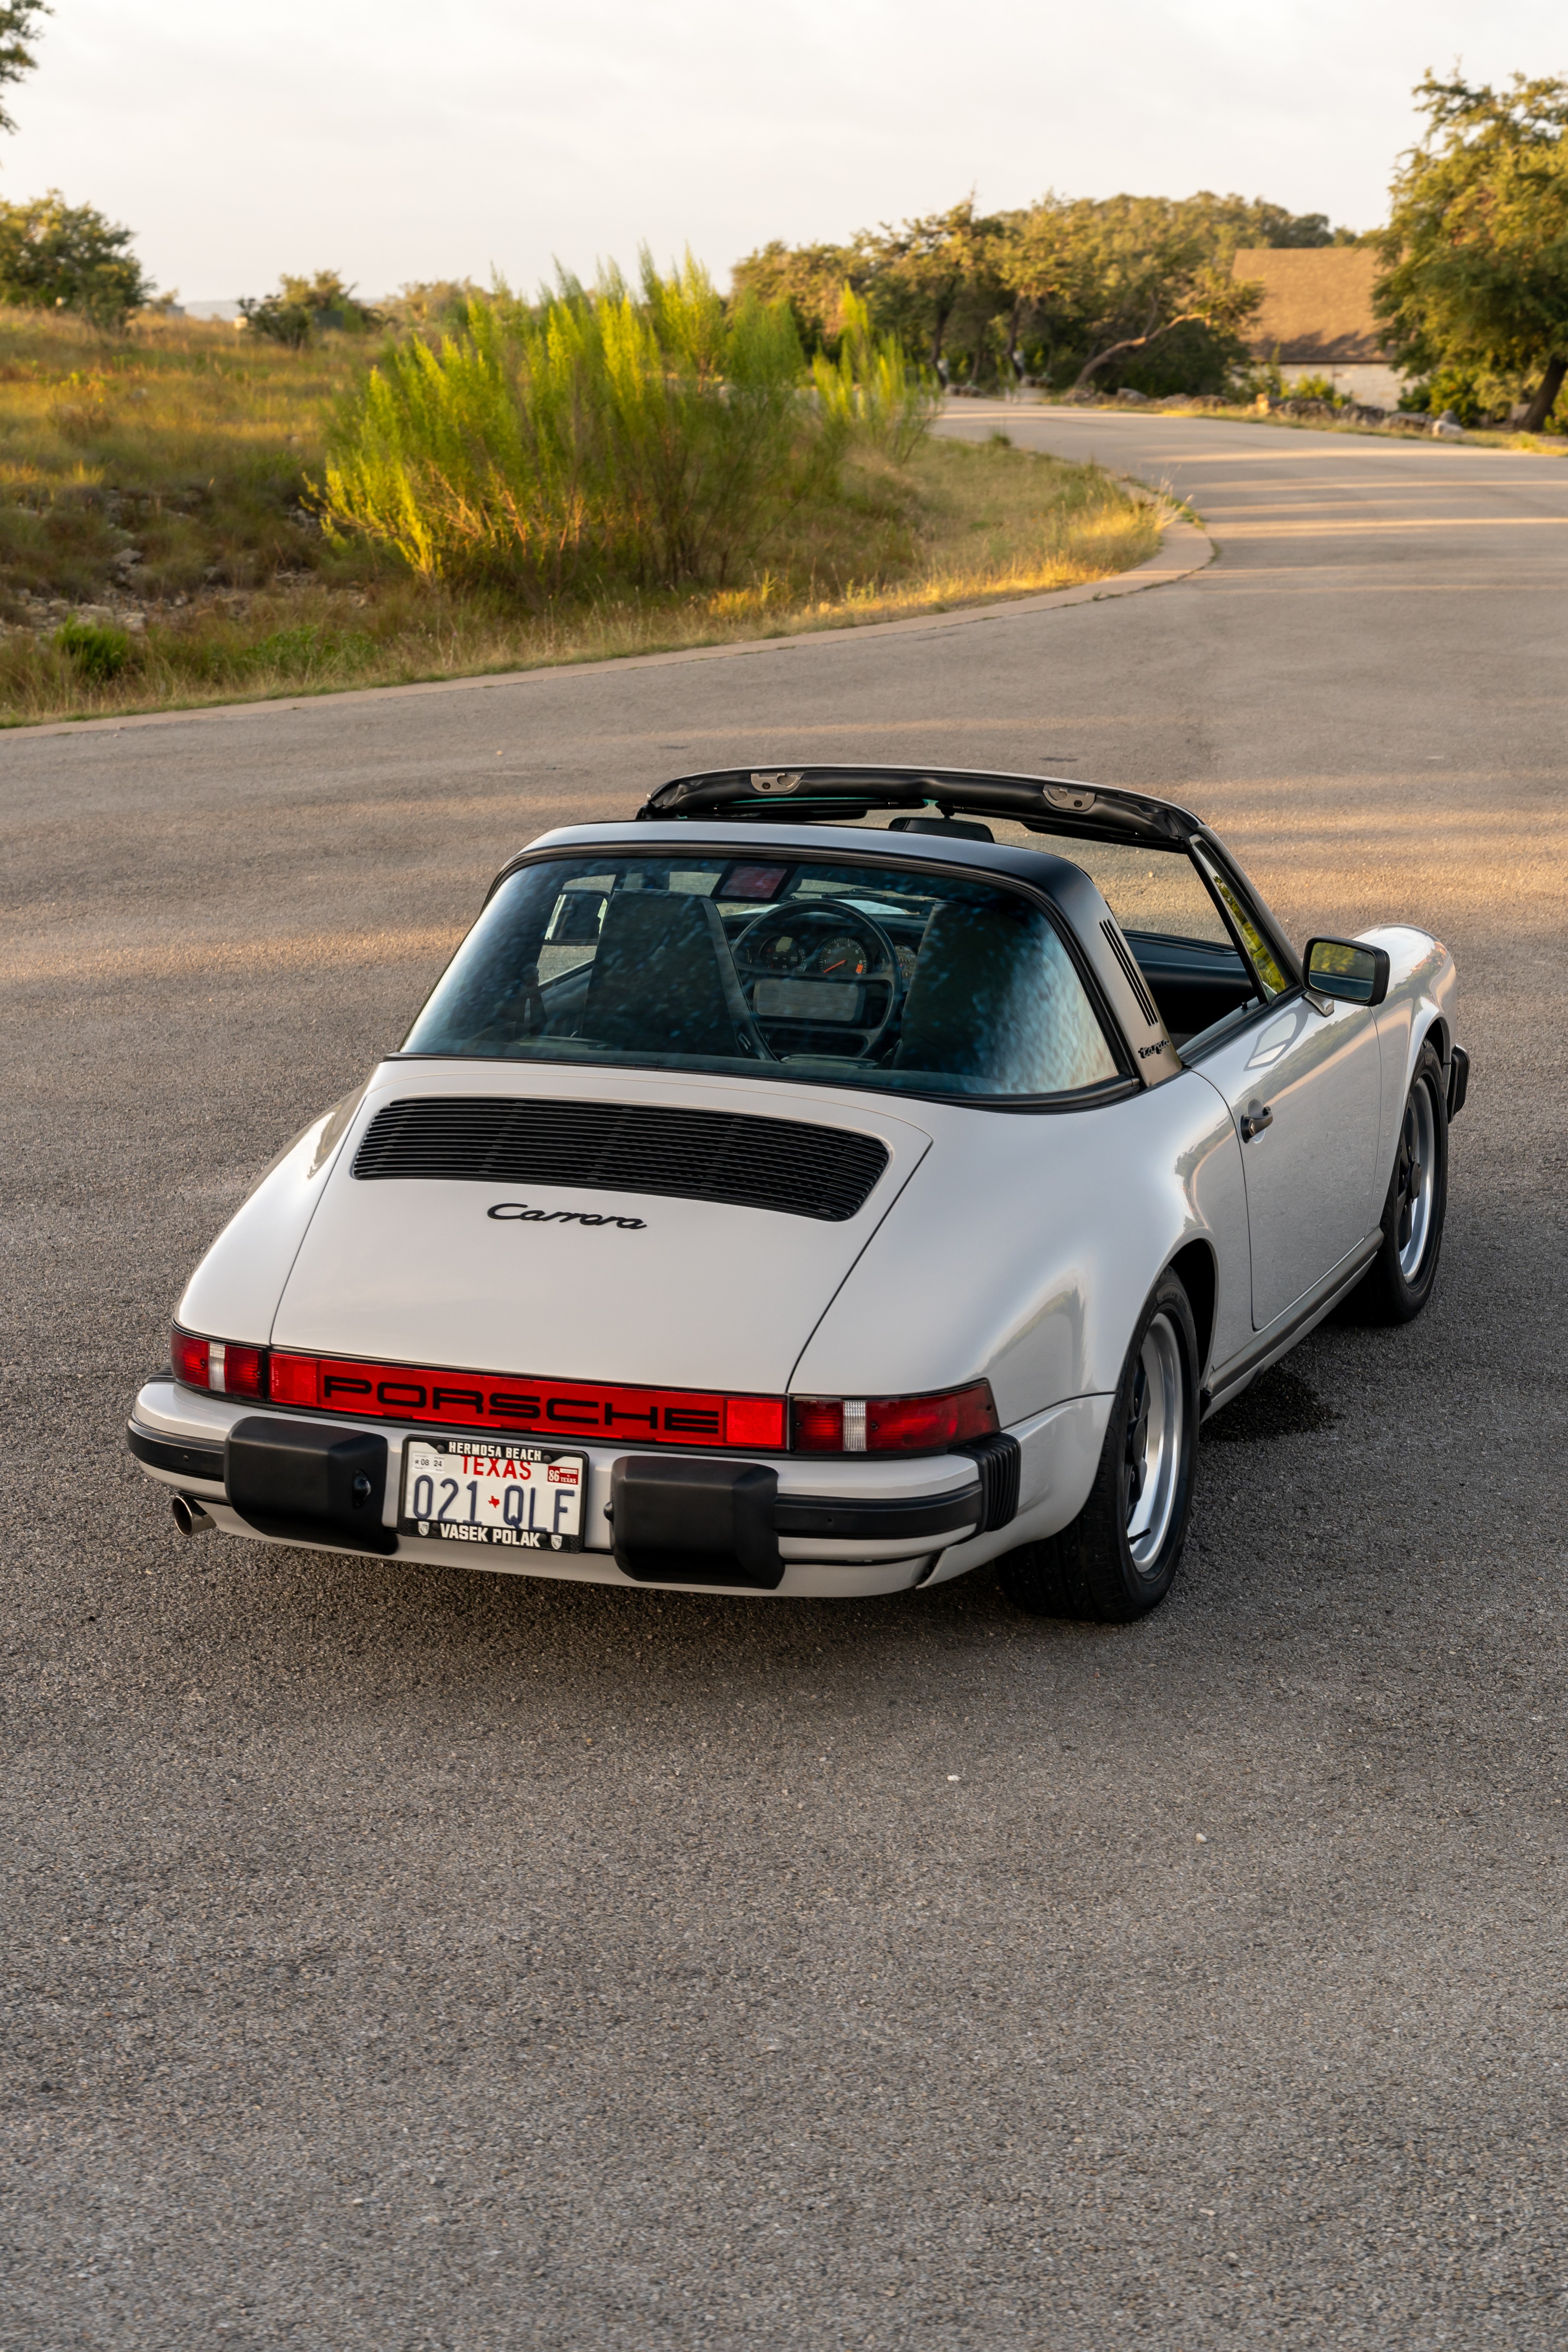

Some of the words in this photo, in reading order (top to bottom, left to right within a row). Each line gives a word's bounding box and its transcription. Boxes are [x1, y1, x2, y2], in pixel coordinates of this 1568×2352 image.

[1138, 1039, 1170, 1059] targa
[487, 1203, 647, 1230] Carrera
[324, 1375, 719, 1435] PORSCHE
[449, 1441, 502, 1458] HERMOSA
[506, 1447, 541, 1461] BEACH
[460, 1455, 532, 1481] TEXAS
[548, 1469, 560, 1482] 86
[413, 1475, 482, 1525] 021
[503, 1484, 575, 1533] QLF
[440, 1523, 488, 1542] VASEK
[492, 1528, 541, 1547] POLAK
